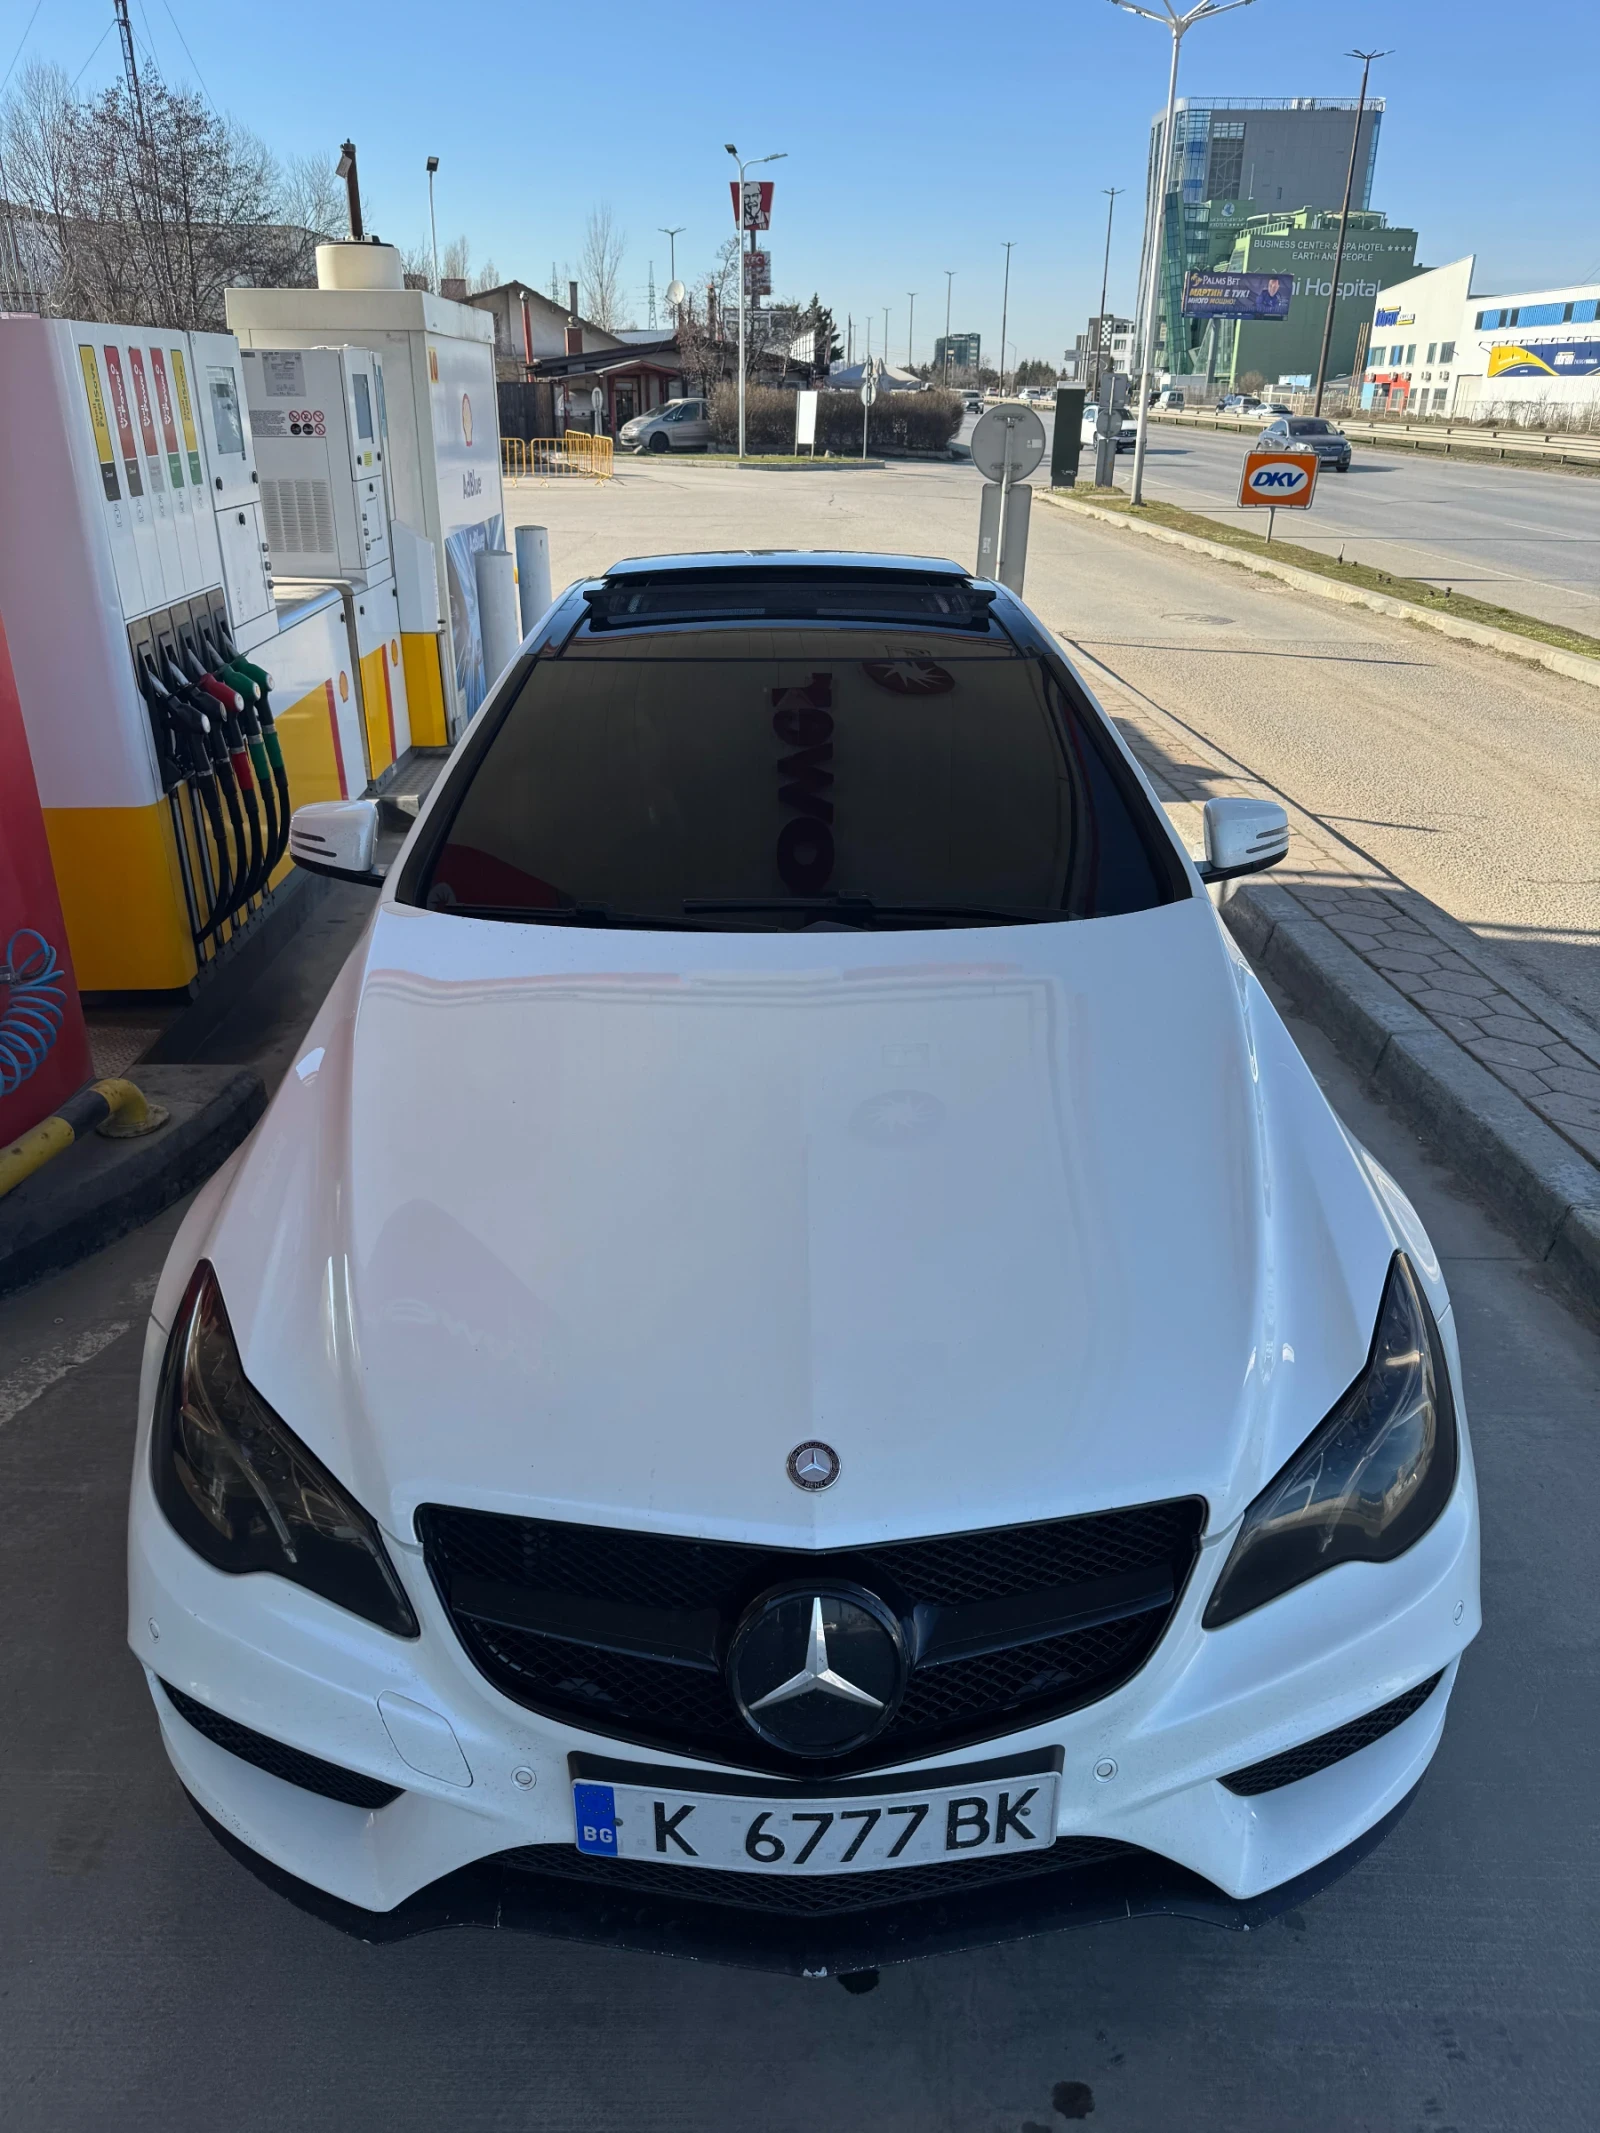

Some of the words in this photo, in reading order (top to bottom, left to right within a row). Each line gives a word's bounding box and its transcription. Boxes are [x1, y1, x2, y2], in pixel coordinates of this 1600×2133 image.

[1254, 240, 1295, 249] BUSINESS
[1297, 241, 1330, 250] CENTER
[1358, 243, 1385, 252] HOTEL
[1292, 252, 1320, 260] EARTH
[1341, 253, 1373, 262] PEOPLE
[1189, 288, 1222, 297] МАРТИН
[1231, 289, 1250, 298] ТУК!
[1305, 277, 1381, 300] Hospital
[90, 363, 105, 428] FuelSave
[115, 369, 129, 428] V-Power
[138, 369, 151, 426] V-Power
[159, 368, 172, 424] V-Power
[462, 469, 482, 499] AdBlue
[1252, 472, 1304, 487] DKV
[583, 1825, 613, 1844] BG
[653, 1801, 699, 1857] K
[745, 1804, 930, 1865] 6777
[945, 1787, 1039, 1851] BK
